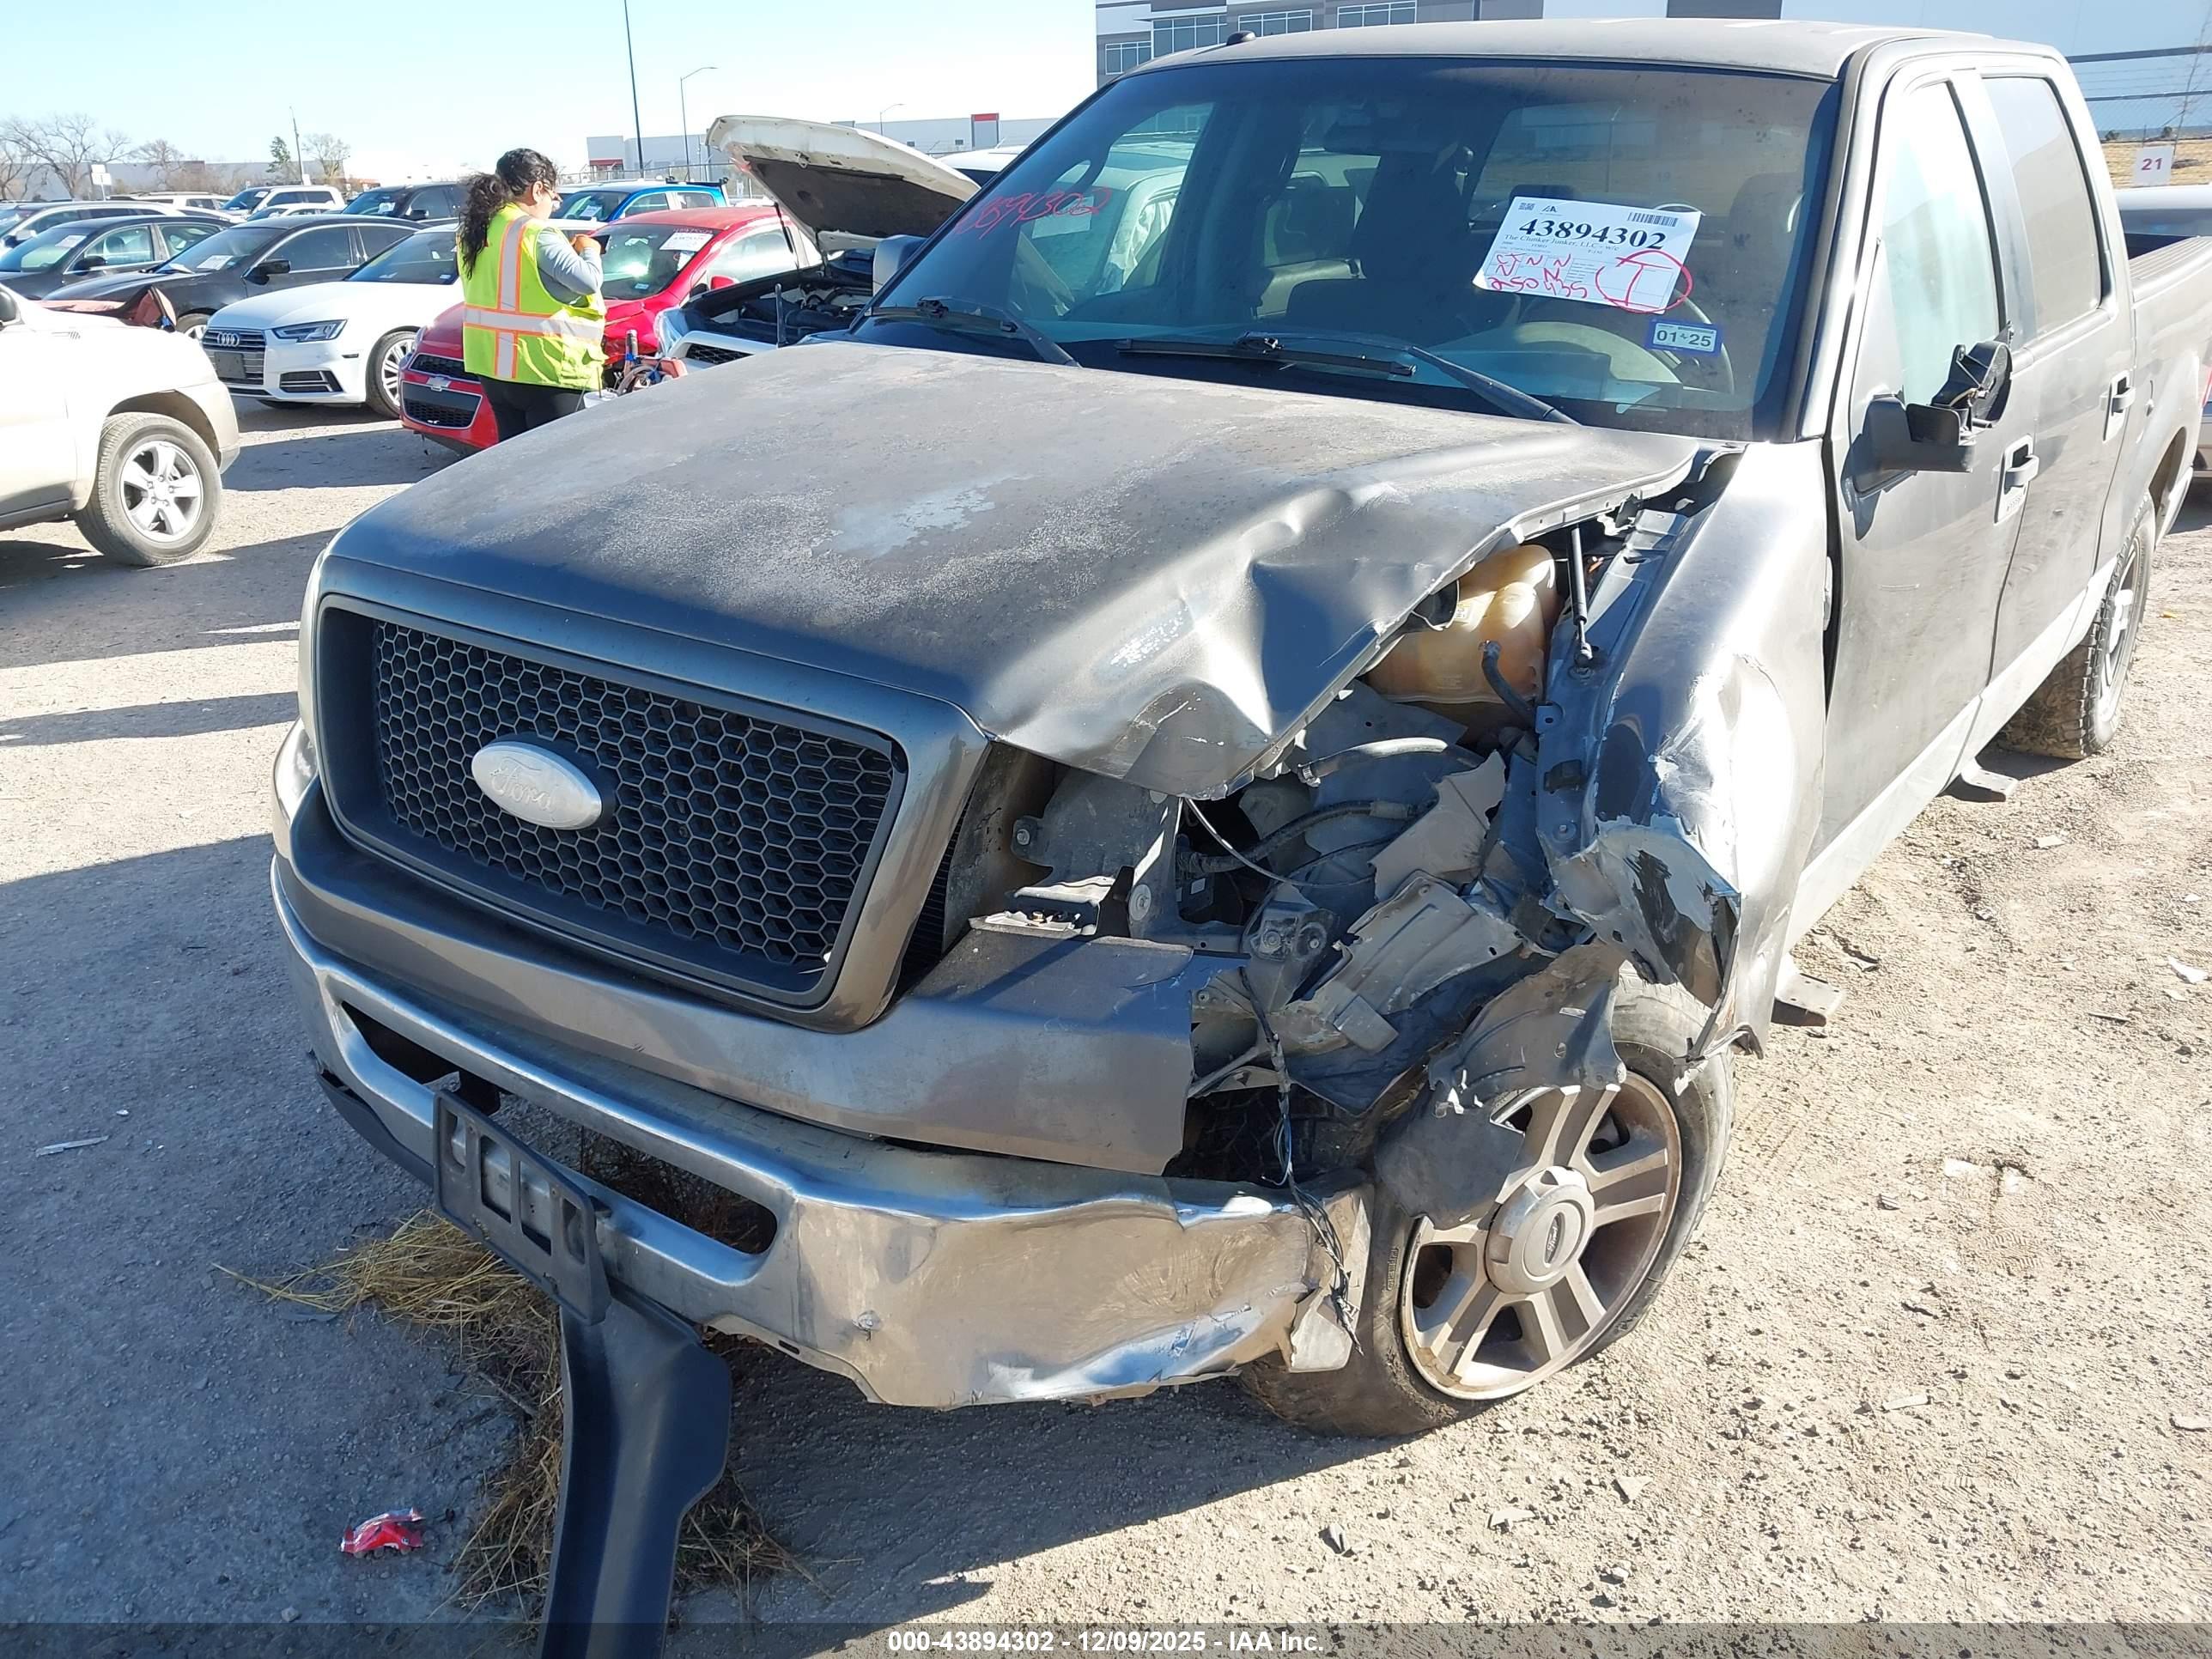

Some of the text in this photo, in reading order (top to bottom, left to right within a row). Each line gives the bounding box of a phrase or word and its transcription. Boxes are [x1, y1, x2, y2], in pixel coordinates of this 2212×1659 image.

[2141, 157, 2164, 171] 21
[1518, 218, 1667, 250] 43894302
[1519, 234, 1551, 244] Clunker
[1656, 330, 1712, 347] 01 25
[489, 757, 558, 811] Ford
